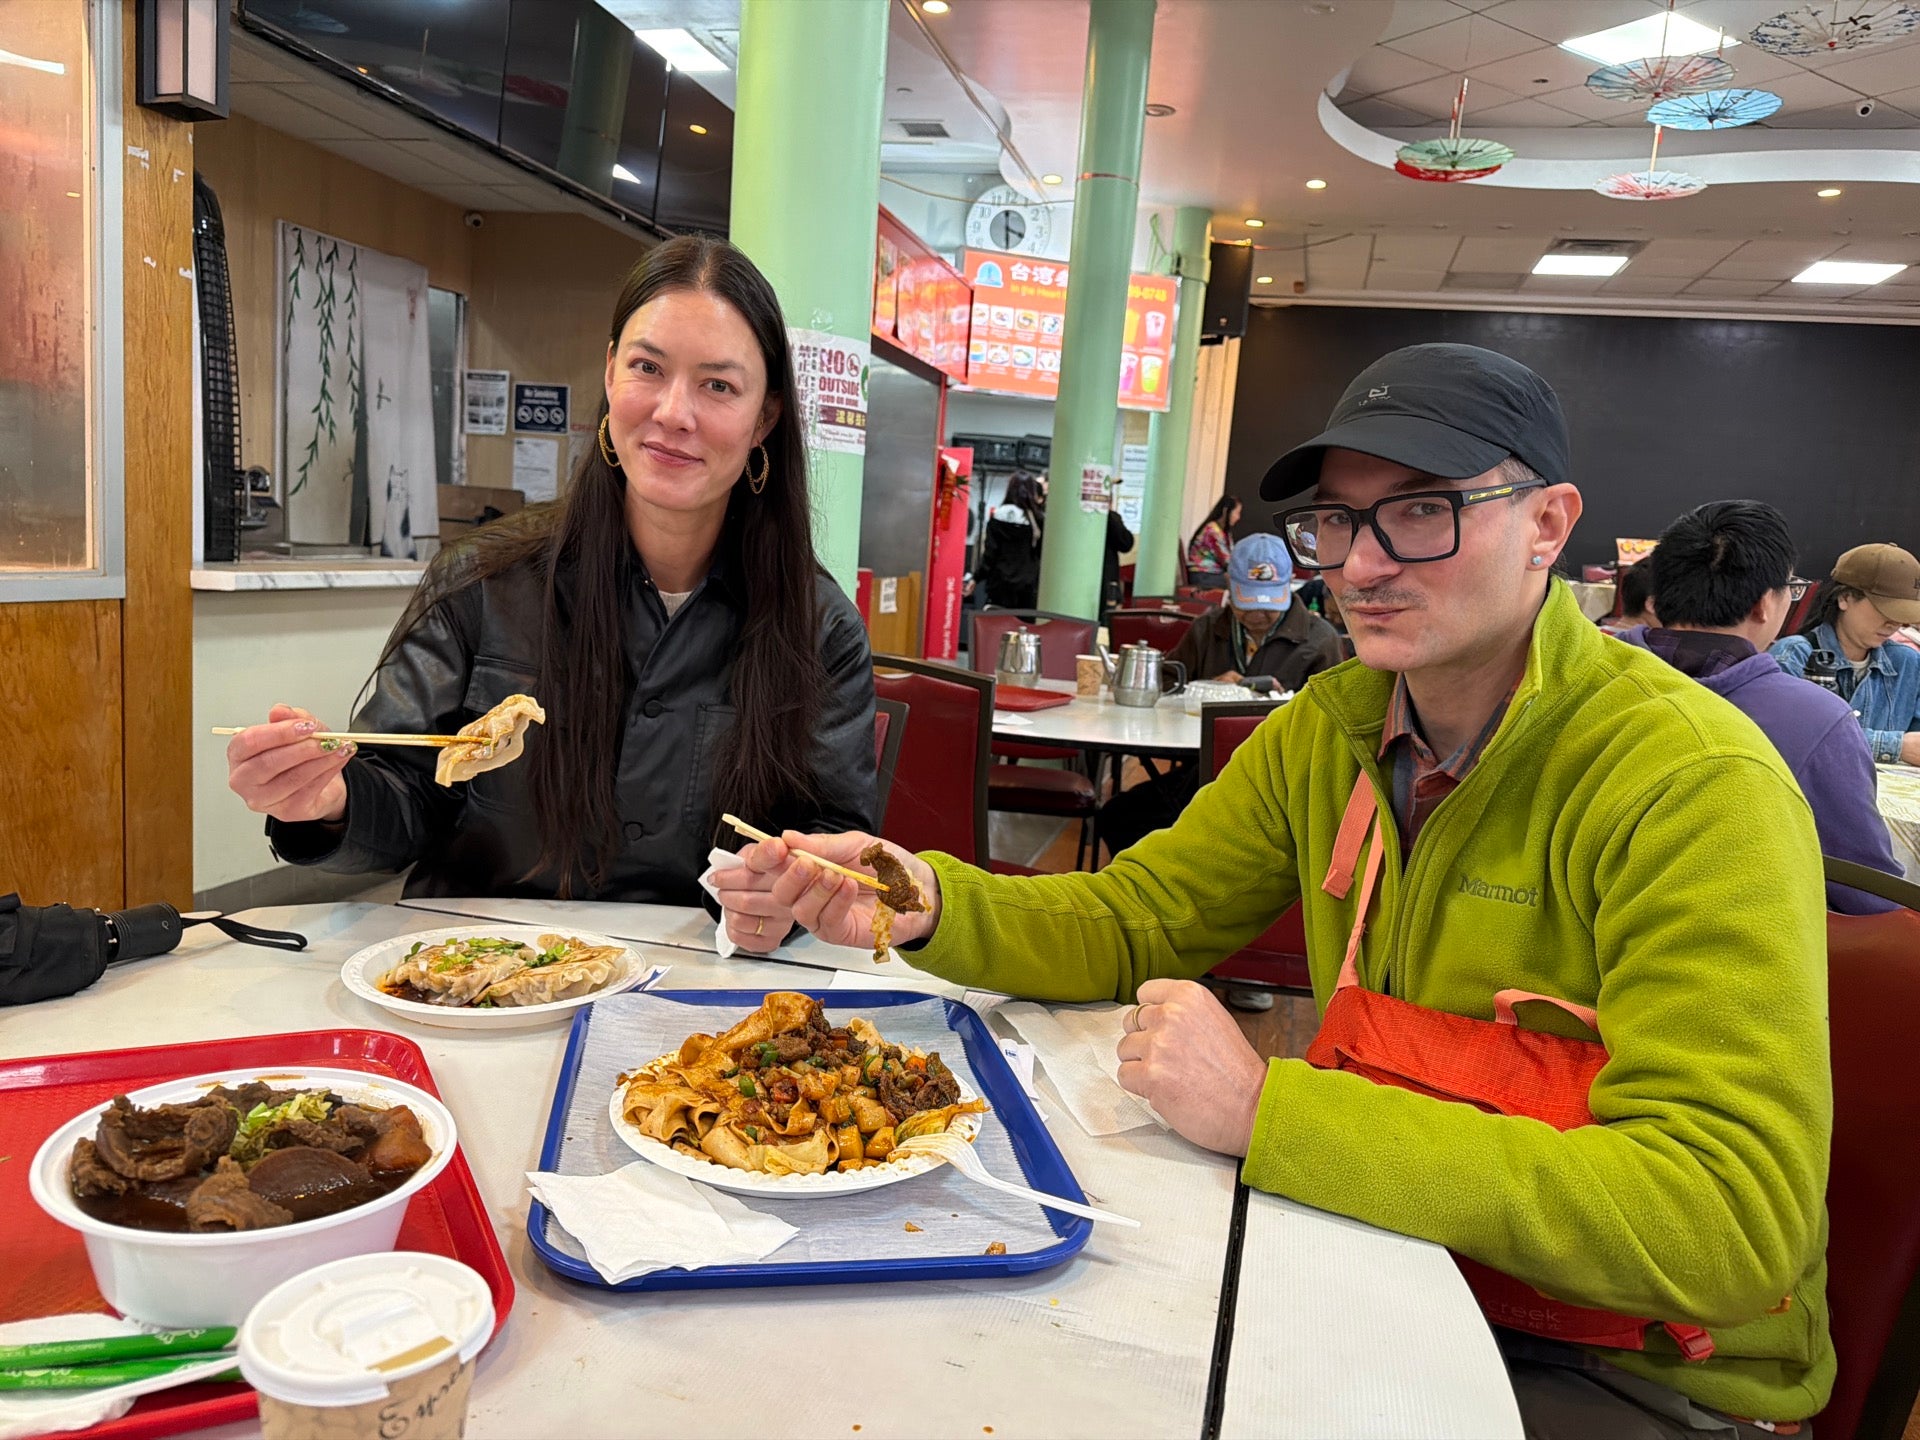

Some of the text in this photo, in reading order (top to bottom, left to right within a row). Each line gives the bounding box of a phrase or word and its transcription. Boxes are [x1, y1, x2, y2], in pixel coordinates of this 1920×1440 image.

[819, 348, 845, 375] NO
[819, 376, 859, 396] OUTSIDE
[1458, 873, 1539, 907] Marmot
